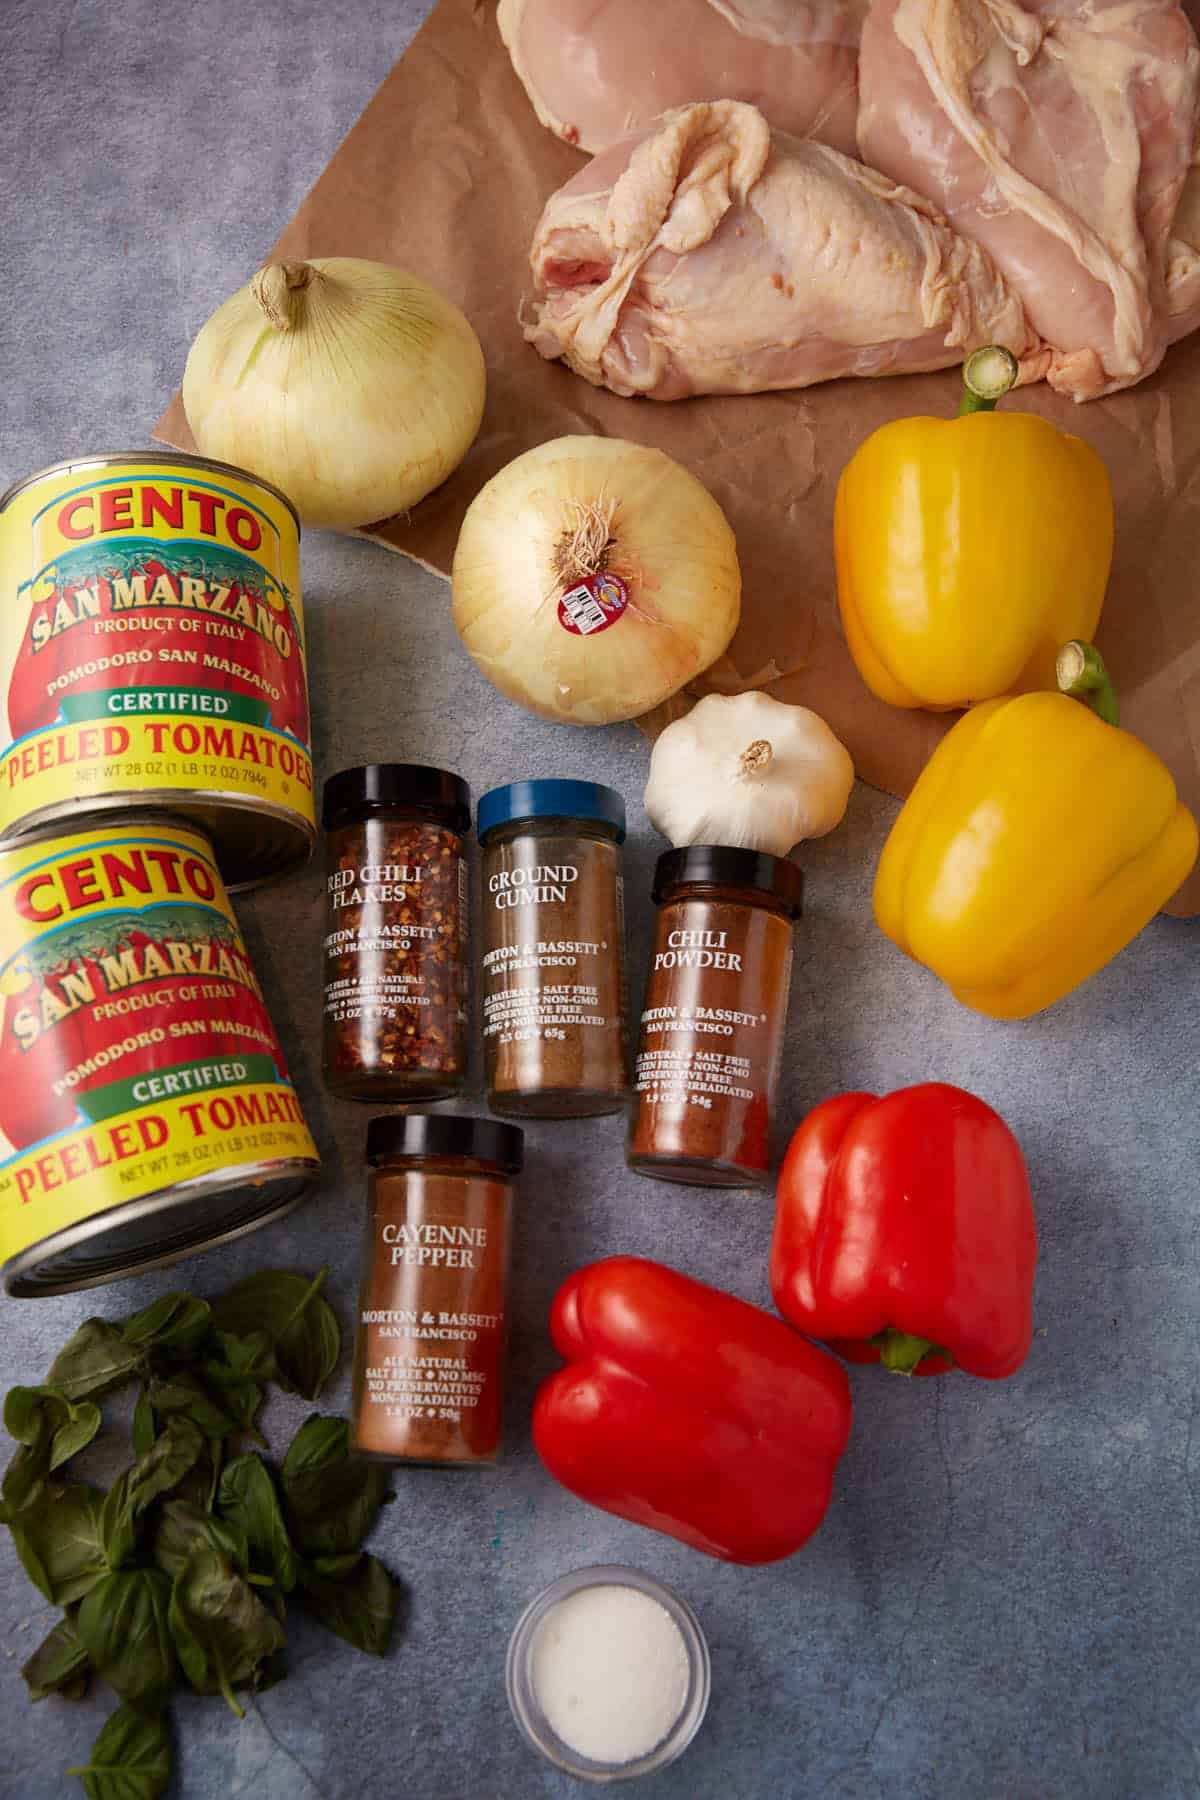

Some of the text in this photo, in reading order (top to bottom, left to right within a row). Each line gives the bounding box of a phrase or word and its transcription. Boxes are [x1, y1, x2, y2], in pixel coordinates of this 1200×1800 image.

[57, 487, 262, 551] CENTO
[32, 574, 291, 661] SAN MARZANO
[93, 617, 246, 641] PRODUCT OF ITALY
[46, 648, 280, 702] POMODORO SAN MARZANO
[107, 692, 229, 714] CERTIFIED
[7, 722, 312, 792] PEELED TOMATOES
[103, 764, 122, 778] WT
[125, 762, 142, 776] 28
[145, 761, 164, 775] OZ
[182, 762, 199, 776] LB
[202, 764, 217, 778] 12
[15, 849, 216, 923] CENTO
[327, 864, 424, 894] RED CHILI
[489, 864, 579, 893] GROUND
[333, 884, 407, 910] FLAKES
[495, 885, 569, 910] CUMIN
[345, 940, 411, 953] FRANCISCO
[668, 930, 728, 949] CHILI
[483, 945, 519, 967] ORTON
[509, 956, 577, 970] FRANCISCO
[654, 950, 742, 972] POWDER
[13, 941, 264, 1052] SAN MARZAN
[543, 985, 570, 995] SALT
[573, 985, 598, 996] FREE
[543, 995, 598, 1006] NON-GMO
[92, 983, 236, 1022] PRODUCT OF ITALY
[556, 1005, 584, 1014] FREE
[641, 1007, 677, 1023] ORTON
[544, 1027, 566, 1041] 65g
[665, 1021, 733, 1036] FRANCISCO
[53, 1027, 165, 1097] POMODORO
[170, 1020, 208, 1039] SAN
[696, 1051, 722, 1064] SALT
[725, 1055, 751, 1068] FREE
[694, 1062, 750, 1079] NON-GMO
[705, 1073, 733, 1085] FREE
[132, 1062, 247, 1102] CERTIFIED
[14, 1115, 169, 1205] PEELED
[119, 1163, 145, 1183] NET
[148, 1158, 169, 1173] WT
[192, 1144, 210, 1159] OZ
[382, 1224, 487, 1247] CAYENNE
[389, 1246, 475, 1269] PEPPER
[362, 1310, 417, 1324] MORTON
[421, 1312, 434, 1324] &
[378, 1327, 477, 1342] SAN FRANCISCO
[407, 1357, 468, 1369] NATURAL
[365, 1367, 390, 1379] SALT
[438, 1370, 458, 1381] NO
[462, 1372, 486, 1384] MSG
[368, 1380, 482, 1395] NO PRESERVATIVES
